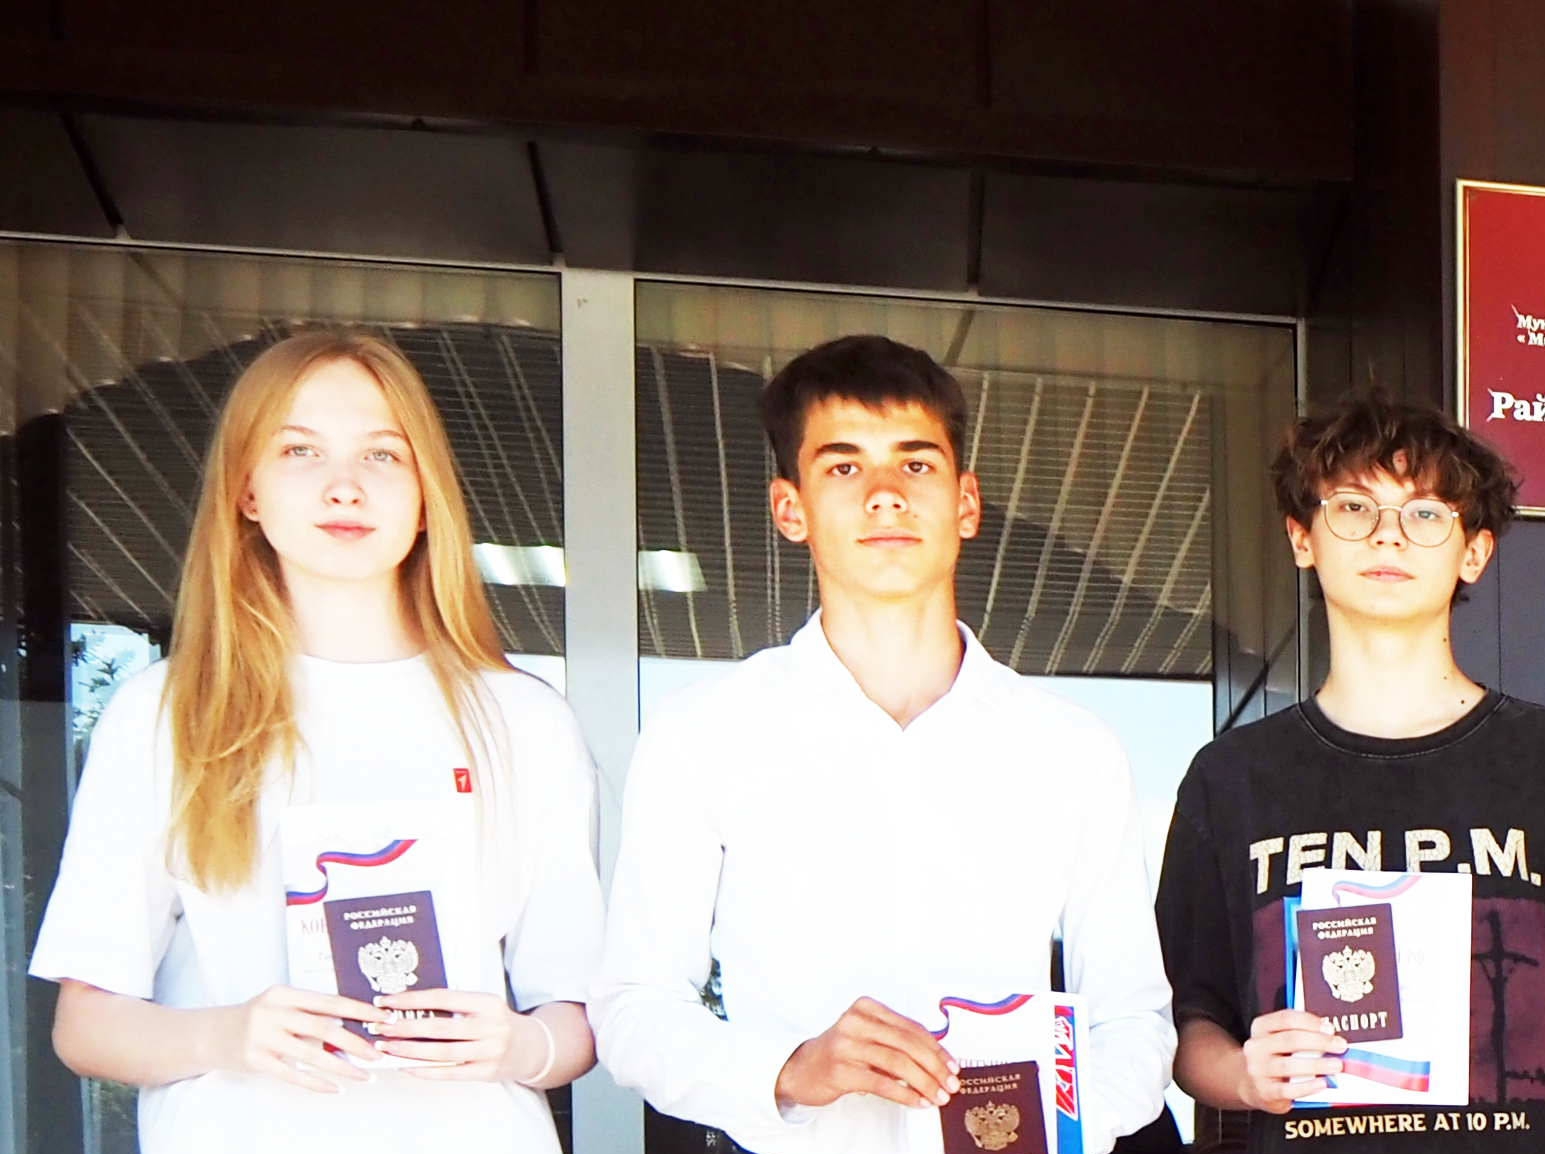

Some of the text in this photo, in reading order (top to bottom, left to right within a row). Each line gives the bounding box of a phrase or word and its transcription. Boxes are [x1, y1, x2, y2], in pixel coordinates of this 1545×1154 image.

[1250, 828, 1542, 894] TEN P.M.
[343, 904, 417, 920] РОССИЙСКАЯ
[350, 915, 414, 930] ФЕДЕРАЦИЯ
[1312, 917, 1377, 931] РОССИЙСКАЯ
[1317, 927, 1374, 940] ФЕДЕРАЦИЯ
[960, 1073, 1021, 1086] ОССИЙСКАЯ
[1285, 1112, 1530, 1139] SOMEWHERE AT 10 P.M.
